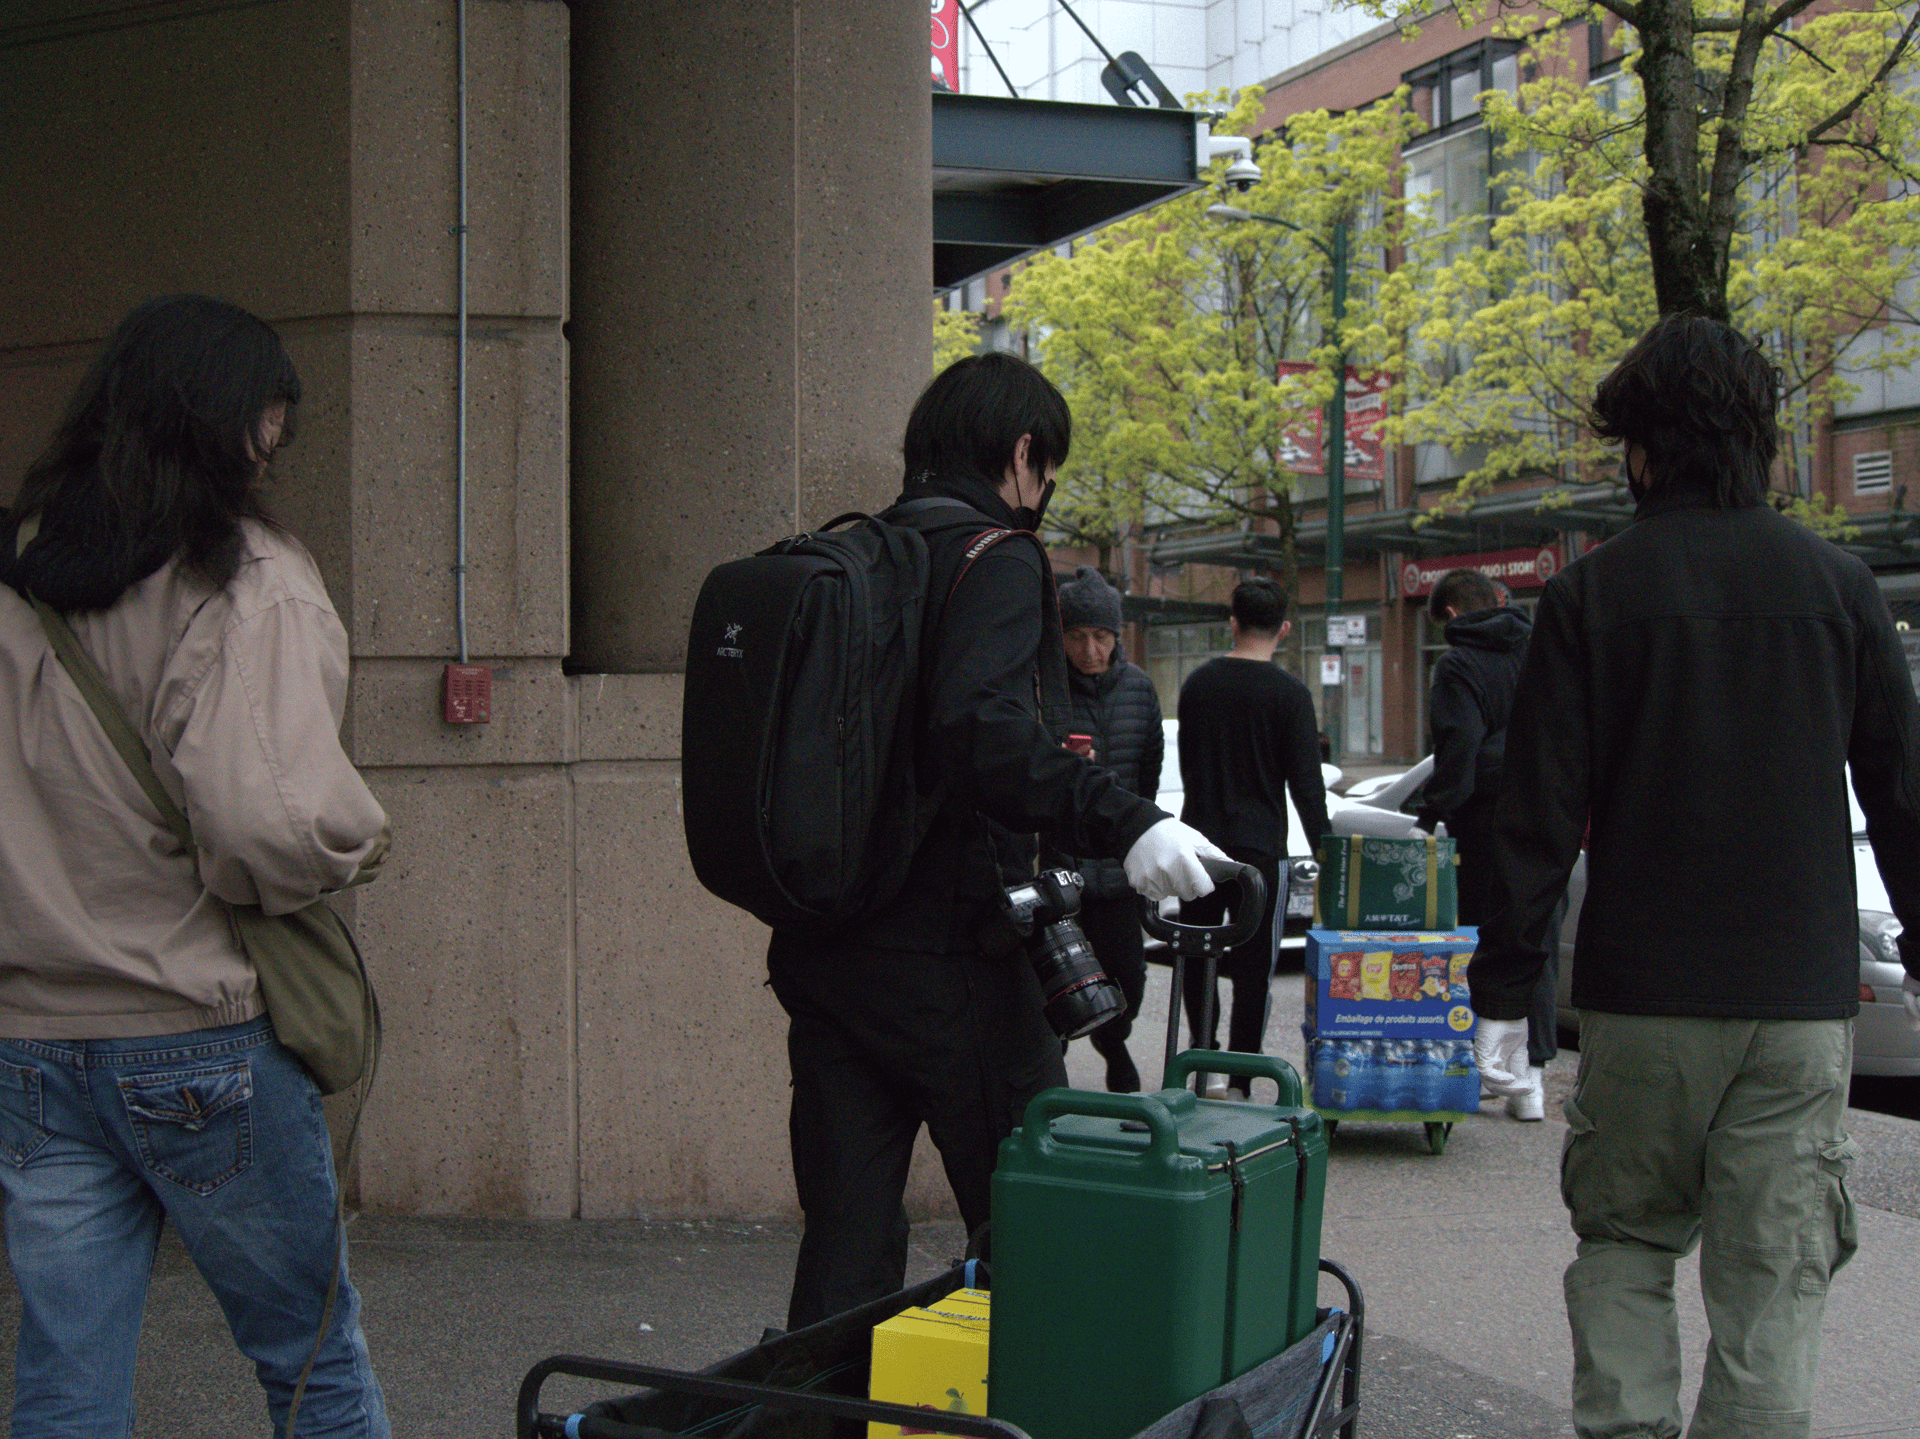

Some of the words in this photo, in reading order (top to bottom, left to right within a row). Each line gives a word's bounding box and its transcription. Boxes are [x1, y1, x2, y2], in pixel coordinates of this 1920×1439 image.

[1508, 560, 1535, 576] STORE
[1391, 963, 1417, 971] Doritos
[1335, 1013, 1374, 1024] Emballage
[1374, 1014, 1384, 1023] de
[1385, 1014, 1416, 1024] produits
[1416, 1015, 1445, 1024] assortis
[1453, 1010, 1469, 1023] 54
